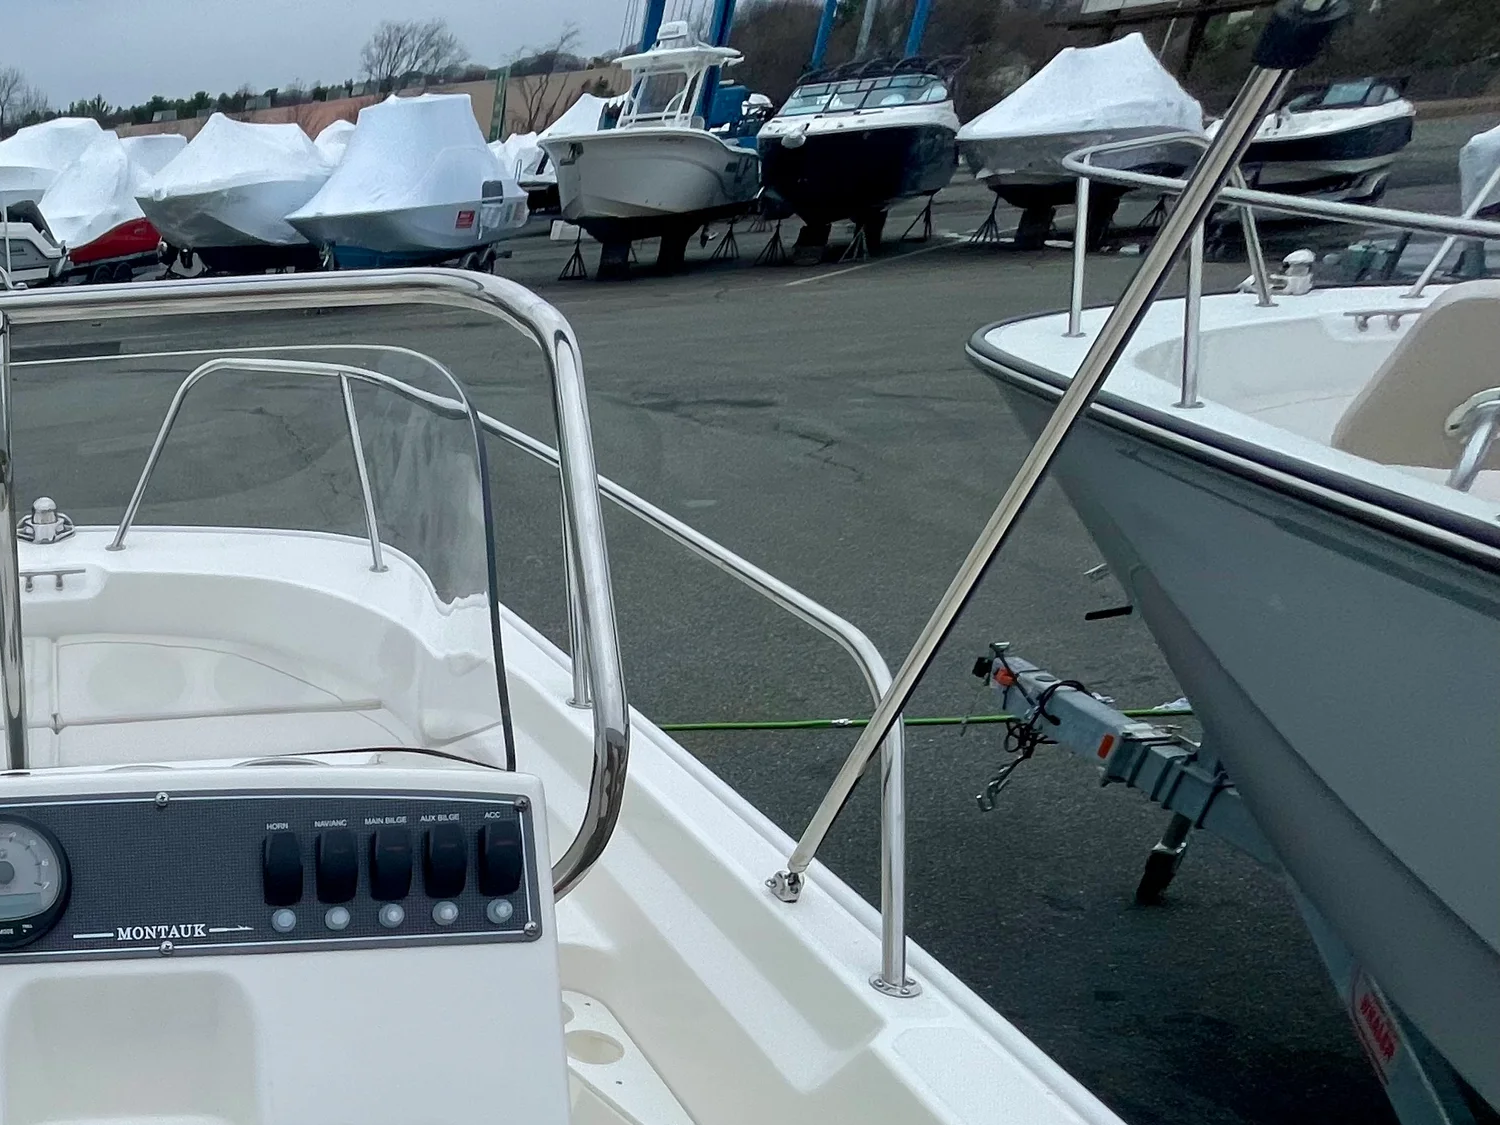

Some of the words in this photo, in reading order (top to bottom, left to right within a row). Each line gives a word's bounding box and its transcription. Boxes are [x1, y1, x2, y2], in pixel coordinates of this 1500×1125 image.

[364, 817, 383, 825] MAIN
[385, 816, 407, 825] BILGE
[420, 814, 436, 822] AUX
[438, 813, 460, 822] BILGE
[315, 819, 347, 828] NAV/ANC
[117, 923, 207, 941] MONTAUK
